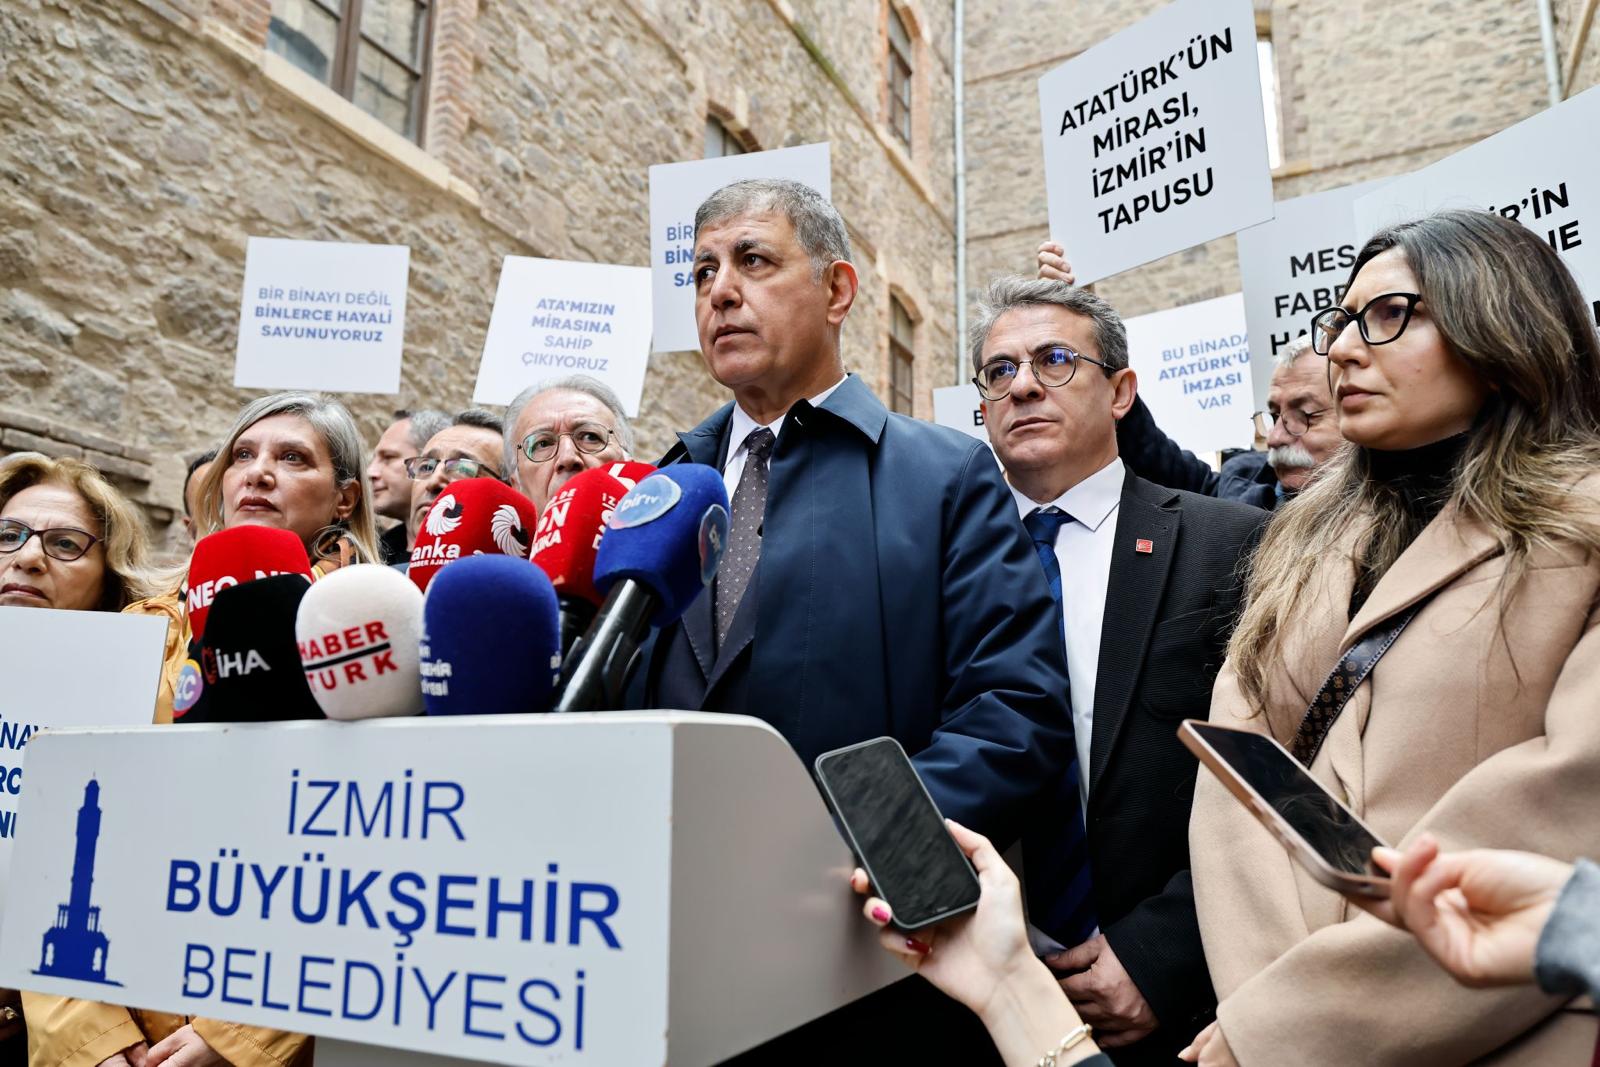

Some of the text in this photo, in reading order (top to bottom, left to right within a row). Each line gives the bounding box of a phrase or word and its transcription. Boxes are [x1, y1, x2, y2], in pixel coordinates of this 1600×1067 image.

[1059, 26, 1233, 136] ATATÜRK'ÜN
[1092, 91, 1199, 158] MİRASI,
[1092, 127, 1206, 198] İZMİR'İN
[1098, 167, 1214, 234] TAPUSU
[1489, 182, 1569, 225] R'İN
[667, 222, 693, 241] BİR
[258, 285, 391, 306] BİR BİNAYI DEĞİL
[536, 298, 616, 316] ATA'MIZIN
[255, 303, 392, 324] BİNLERCE HAYALİ
[531, 313, 612, 334] MİRASINA
[261, 325, 383, 342] SAVUNUYORUZ
[544, 334, 593, 350] SAHİP
[521, 351, 609, 371] ÇIKIYORUZ
[1162, 347, 1184, 362] BU
[1182, 371, 1242, 394] İMZASI
[1198, 393, 1232, 410] VAR
[411, 537, 461, 561] anka
[215, 648, 271, 679] İHA
[288, 768, 466, 841] İZMİR
[166, 848, 623, 951] BÜYÜKŞEHİR
[182, 943, 585, 1052] BELEDİYESİ
